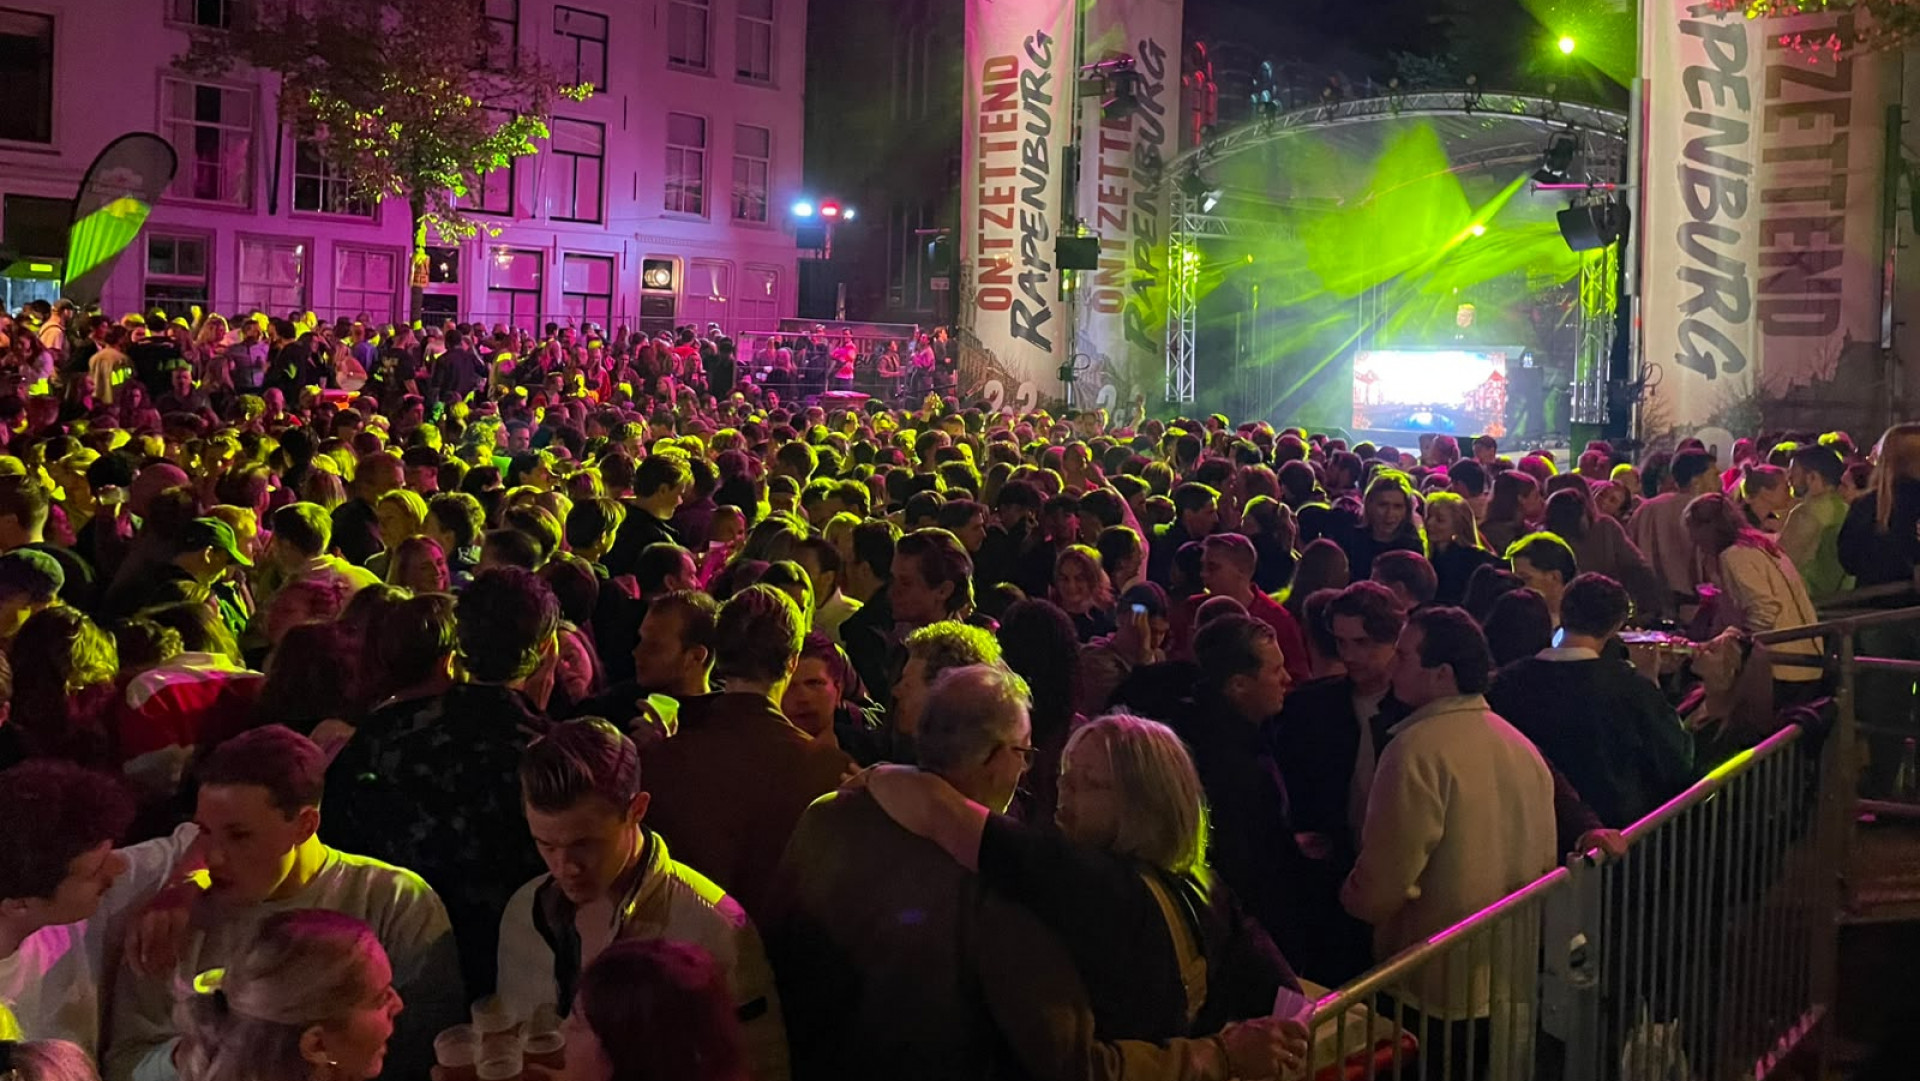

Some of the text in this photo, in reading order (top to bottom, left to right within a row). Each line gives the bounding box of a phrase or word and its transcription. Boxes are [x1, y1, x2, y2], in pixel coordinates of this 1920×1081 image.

[977, 55, 1018, 311] ONTZETTEND
[1010, 29, 1053, 353] RAPENBURG
[1093, 52, 1133, 314] ONTZETTE
[1756, 4, 1854, 336] TZETTEND
